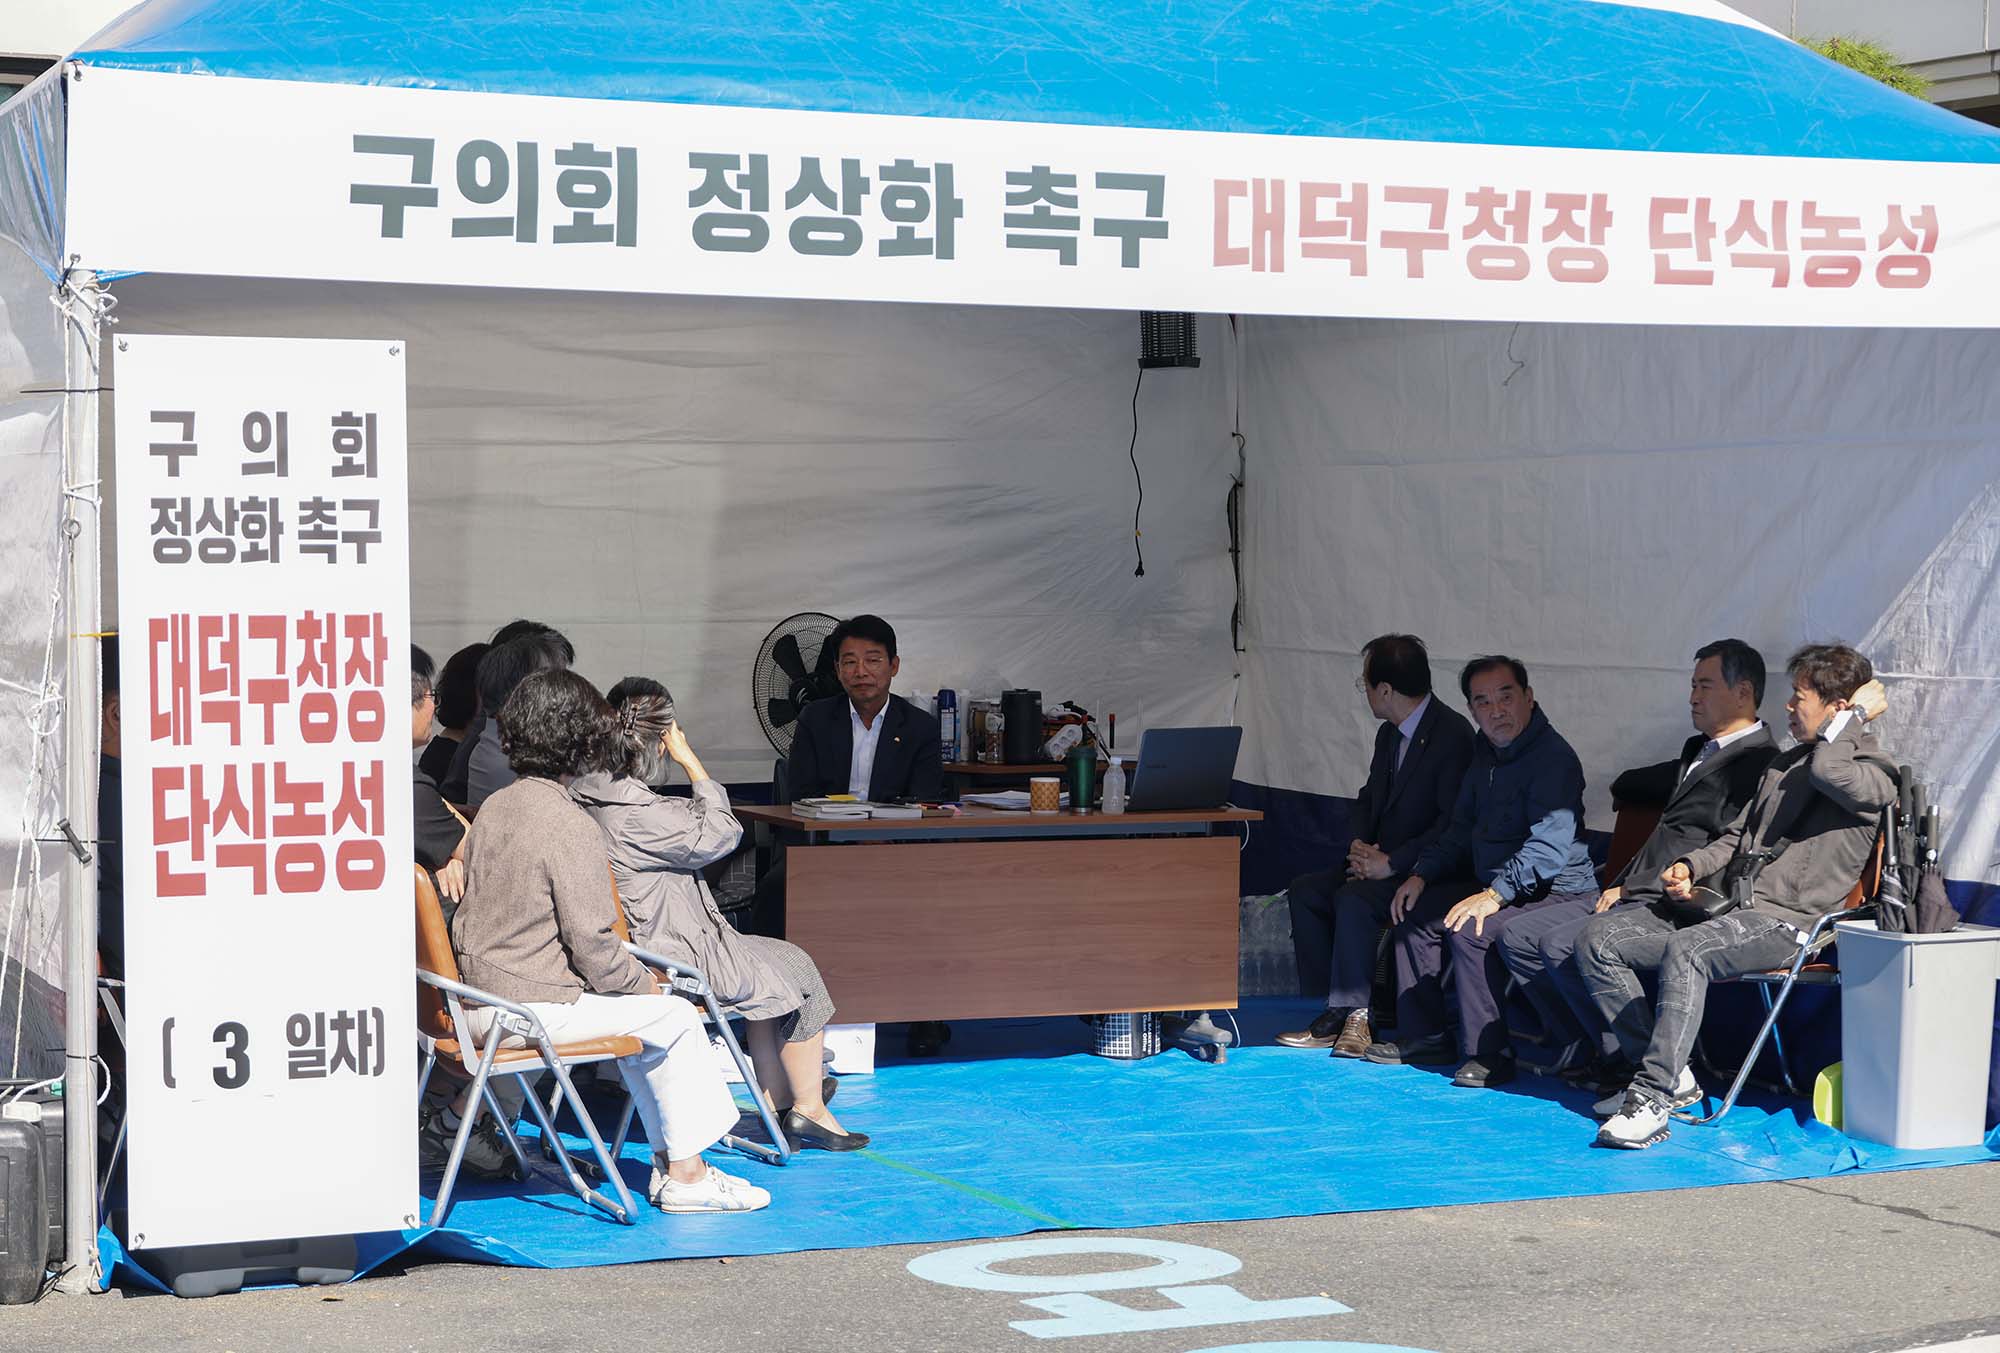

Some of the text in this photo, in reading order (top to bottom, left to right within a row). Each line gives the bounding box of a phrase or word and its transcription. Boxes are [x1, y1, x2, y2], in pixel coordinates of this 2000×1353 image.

[350, 134, 1940, 289] 구의회 정상화 촉구 대덕구청장 단식농성
[150, 495, 382, 565] 정상화 촉구
[148, 610, 389, 747] 대덕구청장
[151, 759, 386, 898] 단식농성
[212, 1021, 251, 1090] 3
